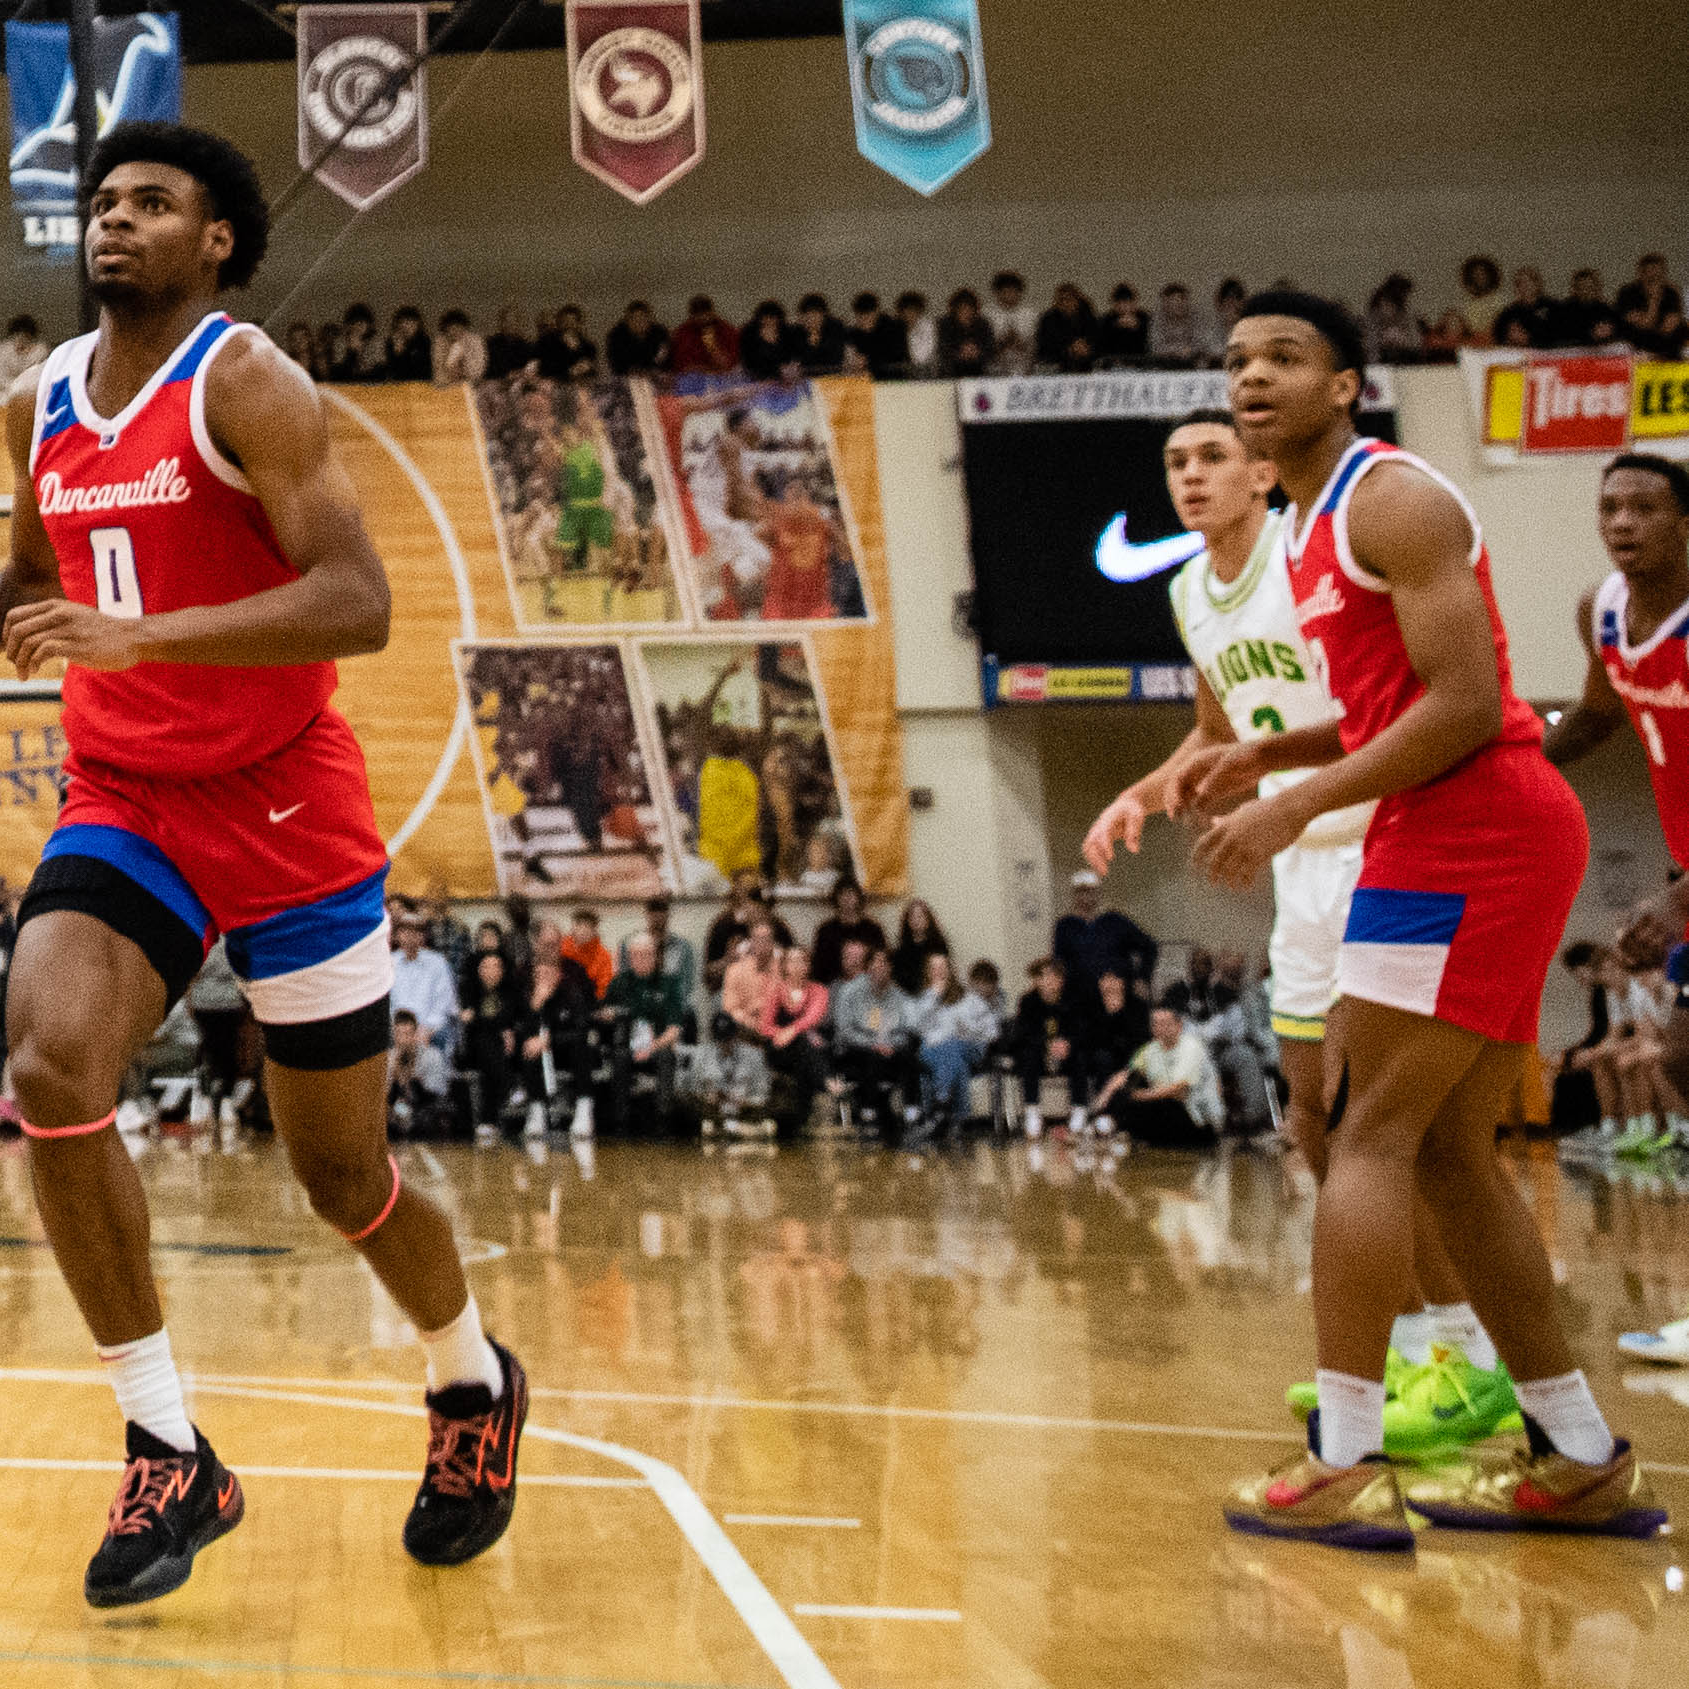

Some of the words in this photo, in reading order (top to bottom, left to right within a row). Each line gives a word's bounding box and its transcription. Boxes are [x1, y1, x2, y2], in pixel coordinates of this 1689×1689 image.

[1527, 367, 1628, 430] Tires
[38, 456, 192, 515] Duncanville
[88, 525, 145, 620] 0
